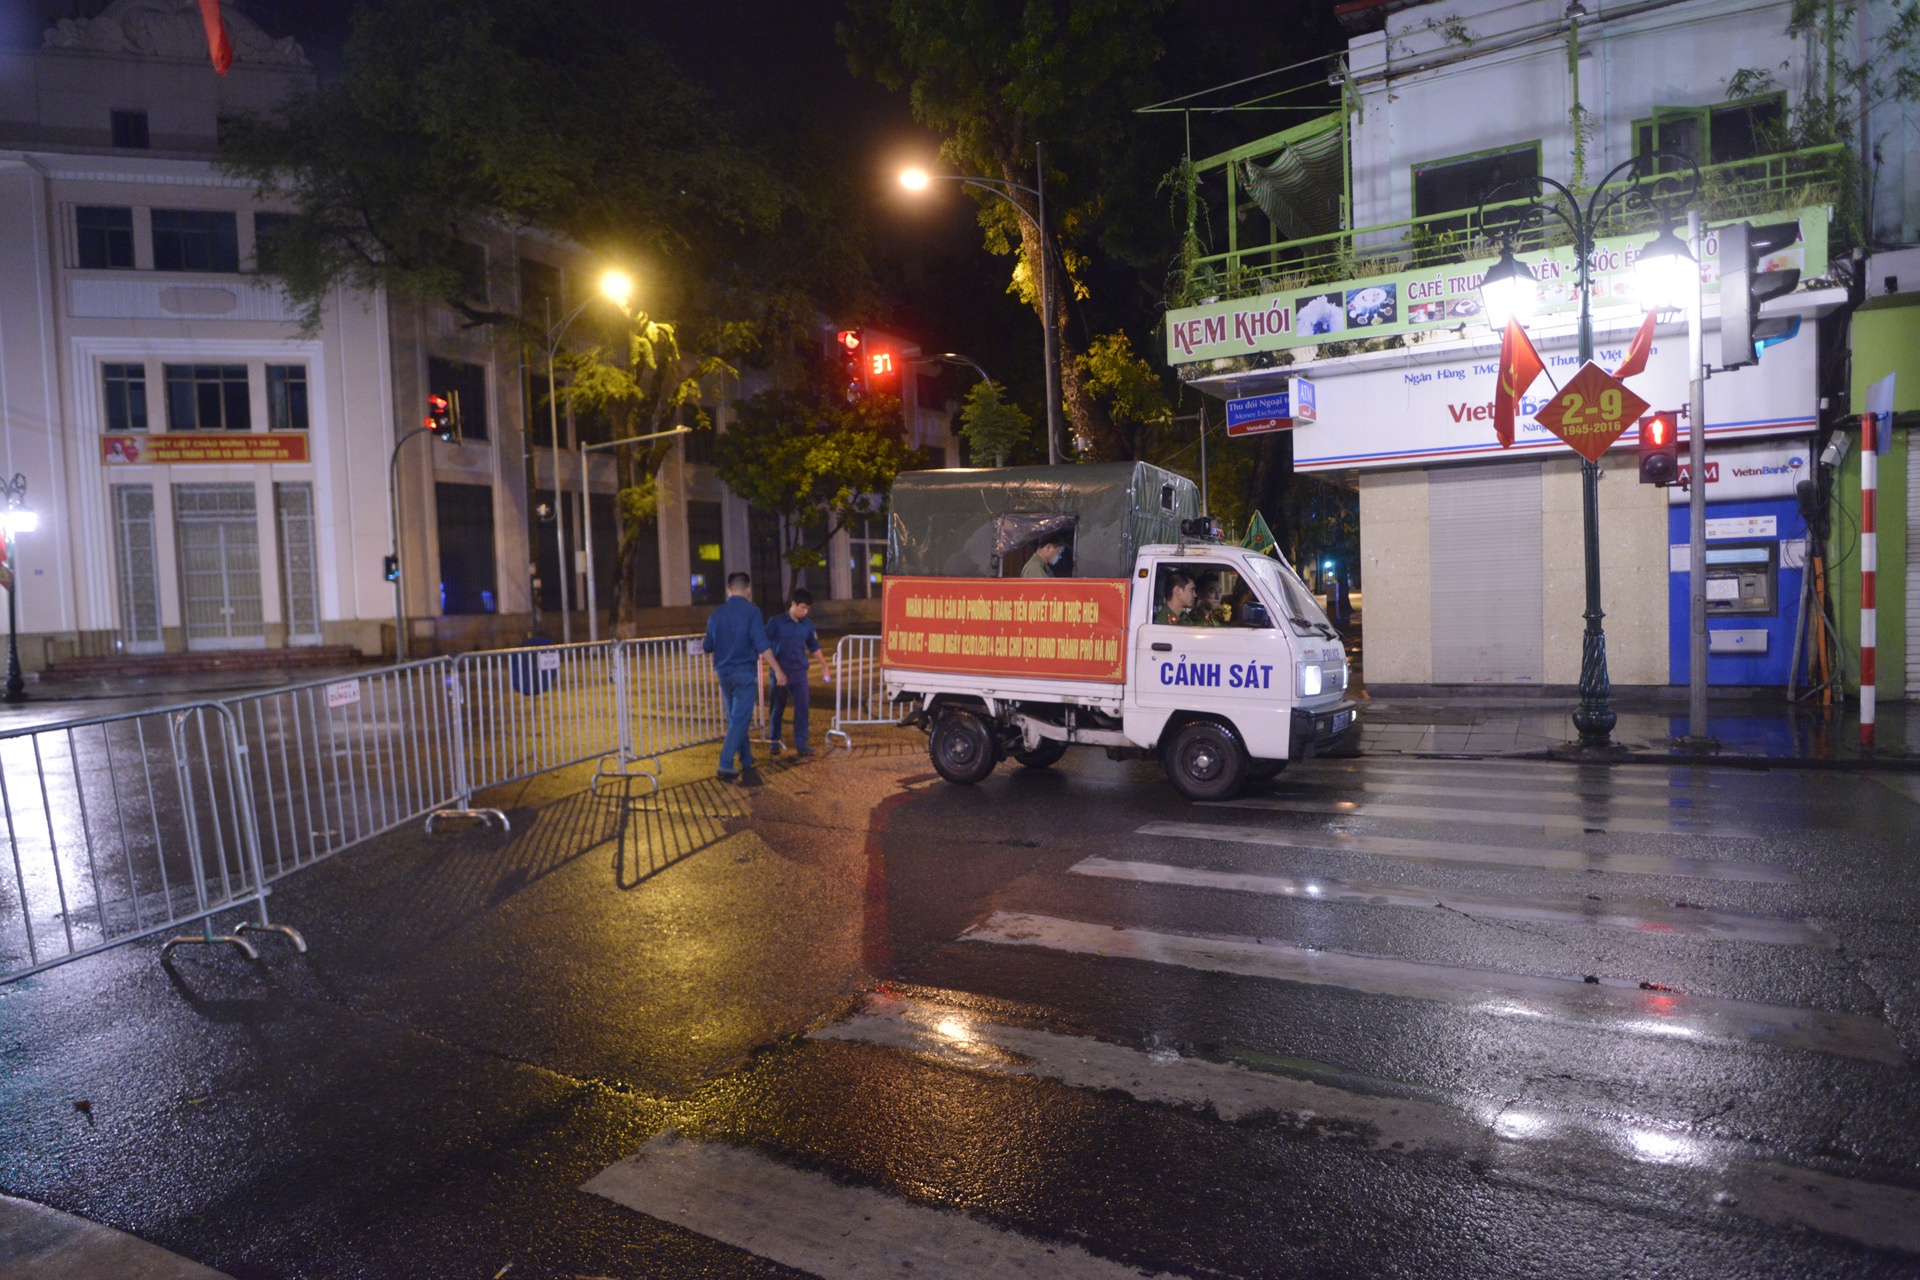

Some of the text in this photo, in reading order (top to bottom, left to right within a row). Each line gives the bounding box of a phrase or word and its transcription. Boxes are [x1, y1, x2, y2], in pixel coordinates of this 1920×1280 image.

[1408, 273, 1442, 300] CAFÉ
[1173, 299, 1290, 355] KEM KHÓI
[1404, 373, 1432, 386] Ngân
[1437, 368, 1465, 383] Hàng
[1472, 363, 1500, 376] TMC
[1600, 348, 1622, 362] Việt
[1229, 403, 1244, 411] Thu
[1259, 396, 1283, 409] Ngoại
[1300, 384, 1313, 403] ATM
[1561, 389, 1623, 425] 2-9
[1235, 407, 1287, 420] Money Exchange
[1562, 421, 1621, 436] 1945-2016
[1678, 465, 1789, 481] AM VietinBank
[905, 594, 922, 617] NHÂN
[922, 594, 935, 618] DÂN
[936, 595, 944, 618] VÀ
[944, 595, 957, 619] CÁN
[957, 595, 966, 624] BỘ
[966, 594, 992, 620] PHƯỜNG
[992, 596, 1012, 621] TRÀNG
[1028, 593, 1048, 624] QUYẾT
[1049, 597, 1063, 622] TÂM
[1064, 599, 1082, 627] THỰC
[1082, 598, 1099, 628] HIỆN
[888, 624, 898, 651] CHỈ
[899, 631, 908, 655] THỊ
[928, 633, 945, 653] UBND
[945, 630, 961, 654] NGÀY
[995, 627, 1008, 657] CỦA
[1009, 628, 1022, 657] CHỦ
[1023, 637, 1037, 662] TỊCH
[1038, 637, 1056, 659] UBND
[1057, 634, 1079, 660] THÀNH
[1079, 632, 1095, 660] PHỐ
[1094, 635, 1104, 661] HÀ
[1104, 635, 1118, 666] NỘI
[1322, 648, 1340, 662] POLICE
[1160, 654, 1273, 689] CẢNH SÁT
